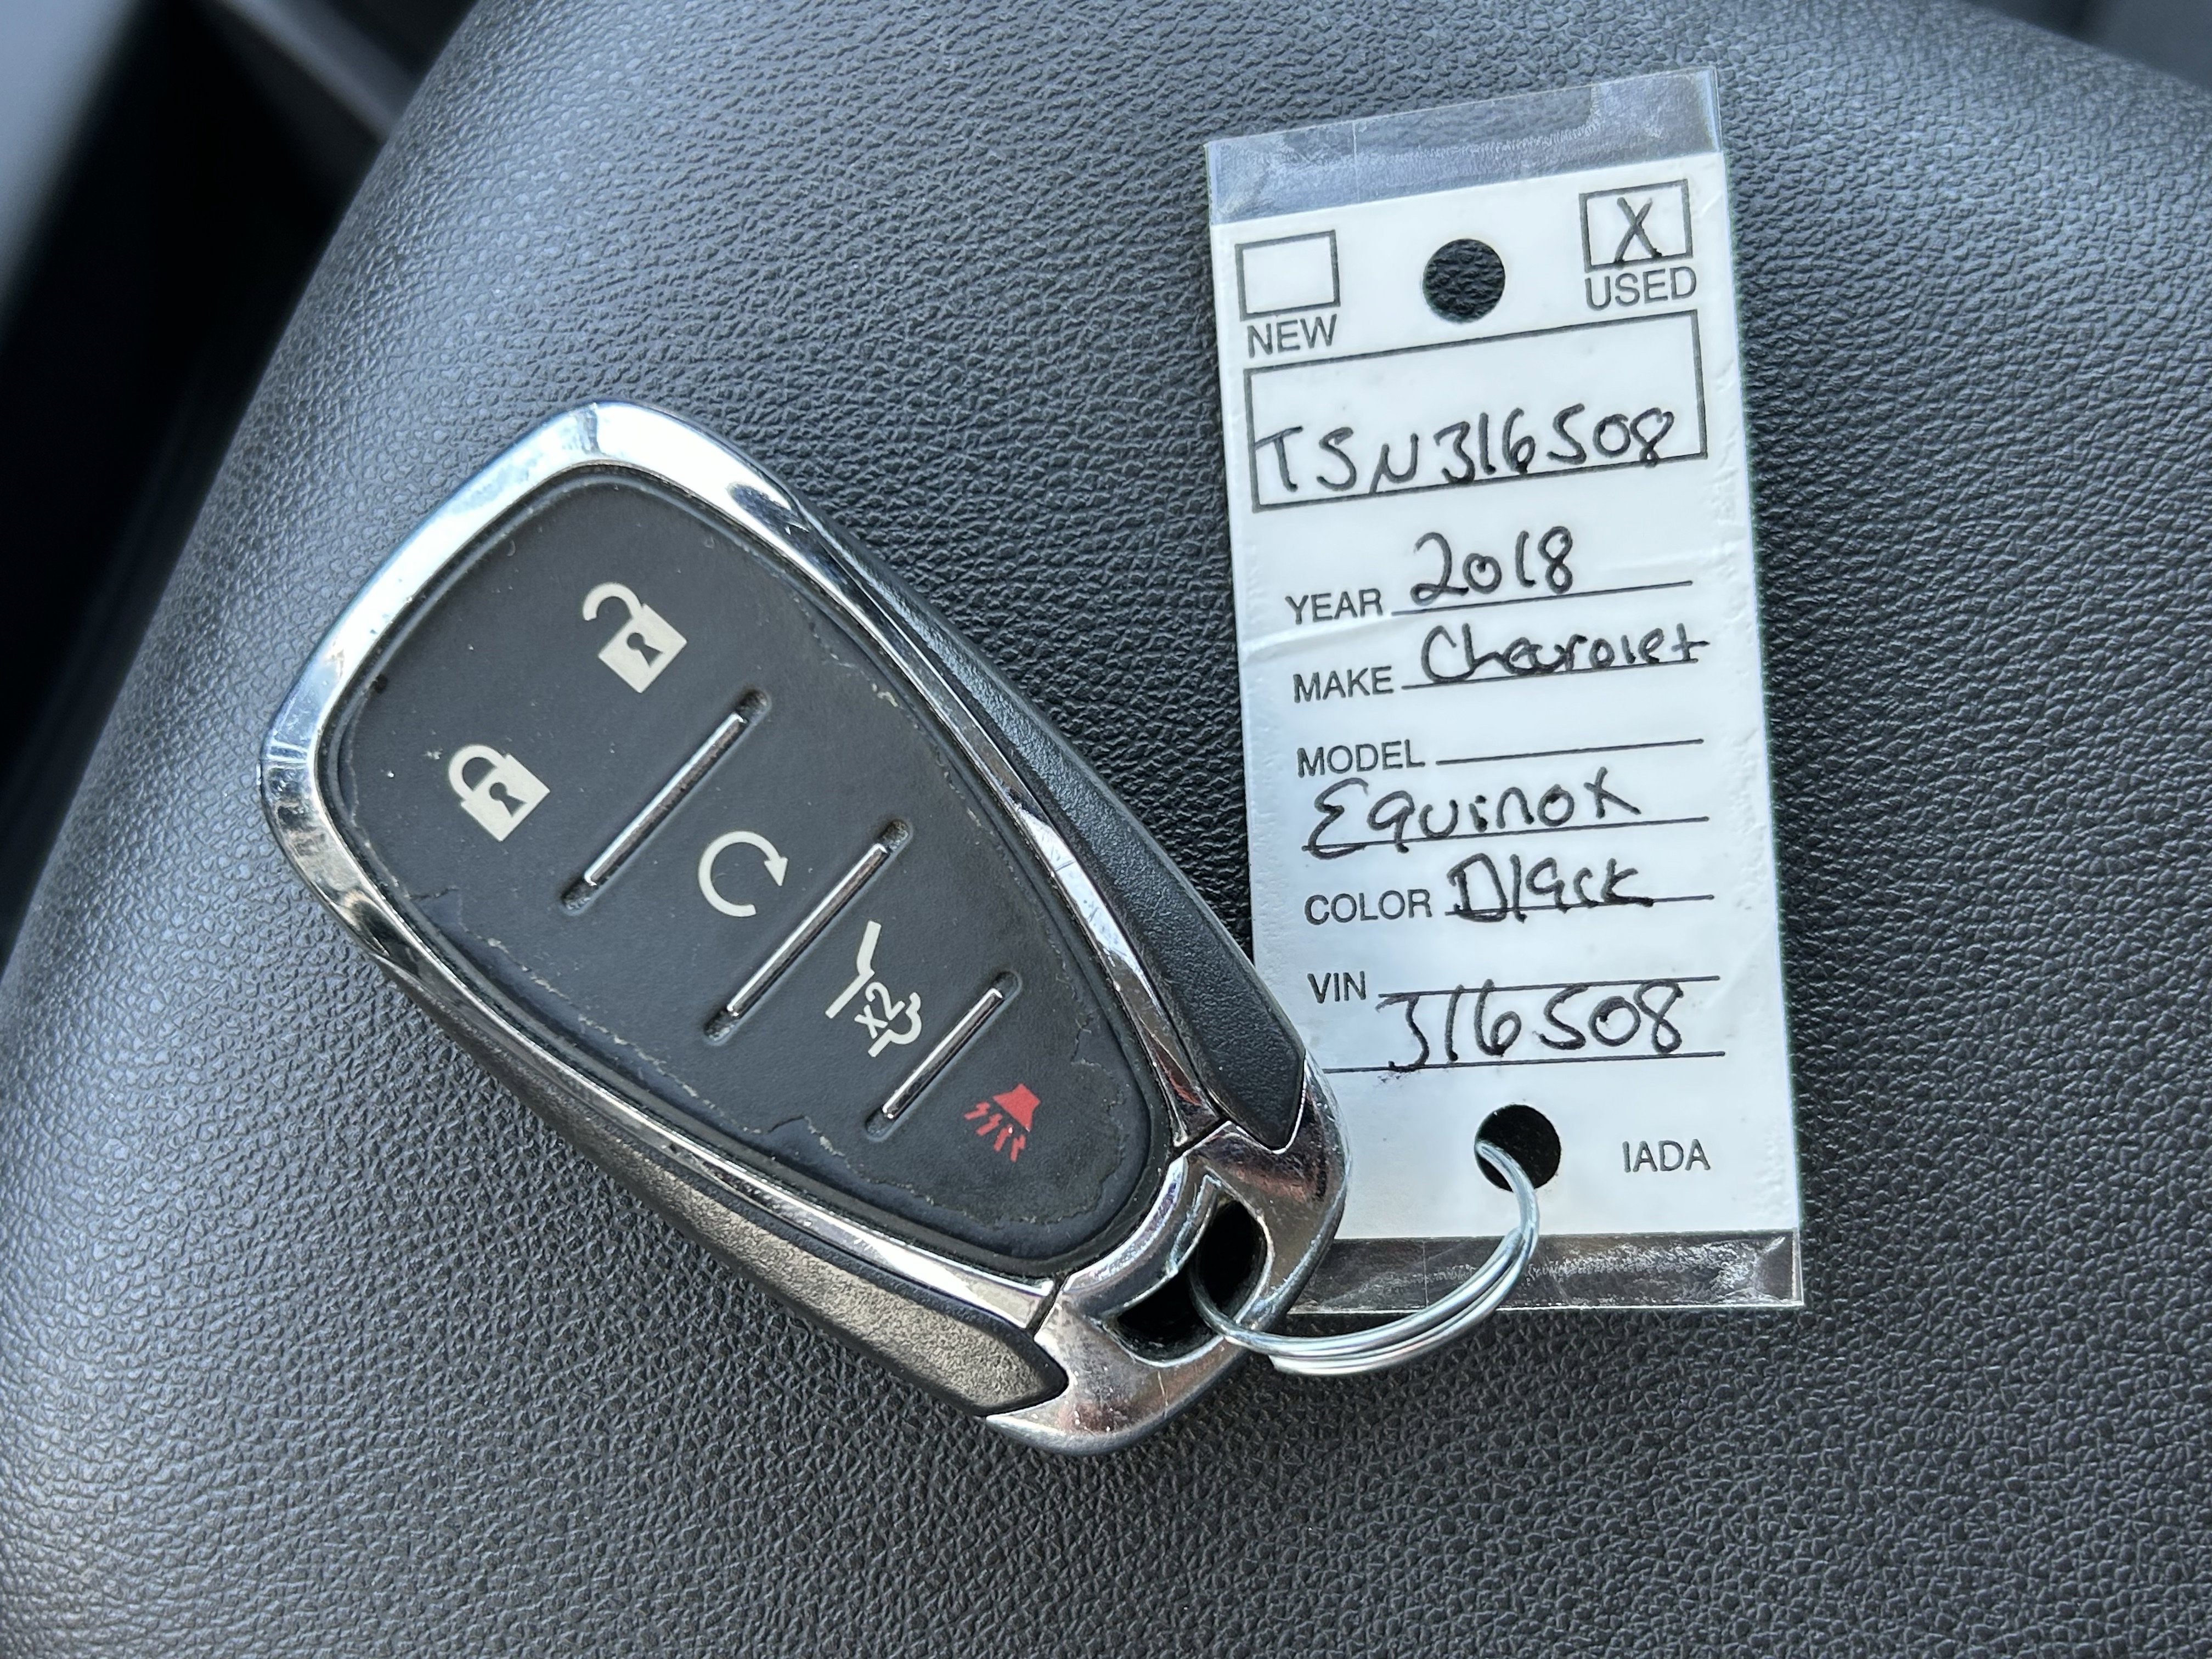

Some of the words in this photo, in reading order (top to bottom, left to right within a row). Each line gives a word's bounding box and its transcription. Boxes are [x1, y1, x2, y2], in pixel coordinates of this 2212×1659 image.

[1615, 196, 1663, 264] X
[1585, 267, 1697, 311] USED
[1248, 314, 1338, 358] NEW
[1410, 526, 1573, 606] 2018
[1285, 587, 1384, 624] YEAR
[1293, 665, 1395, 703] MAKE
[1296, 739, 1426, 778] MODEL
[1304, 889, 1433, 926] COLOR
[1307, 970, 1367, 1004] VIN
[854, 981, 905, 1039] x2
[1622, 1138, 1711, 1173] IADA
